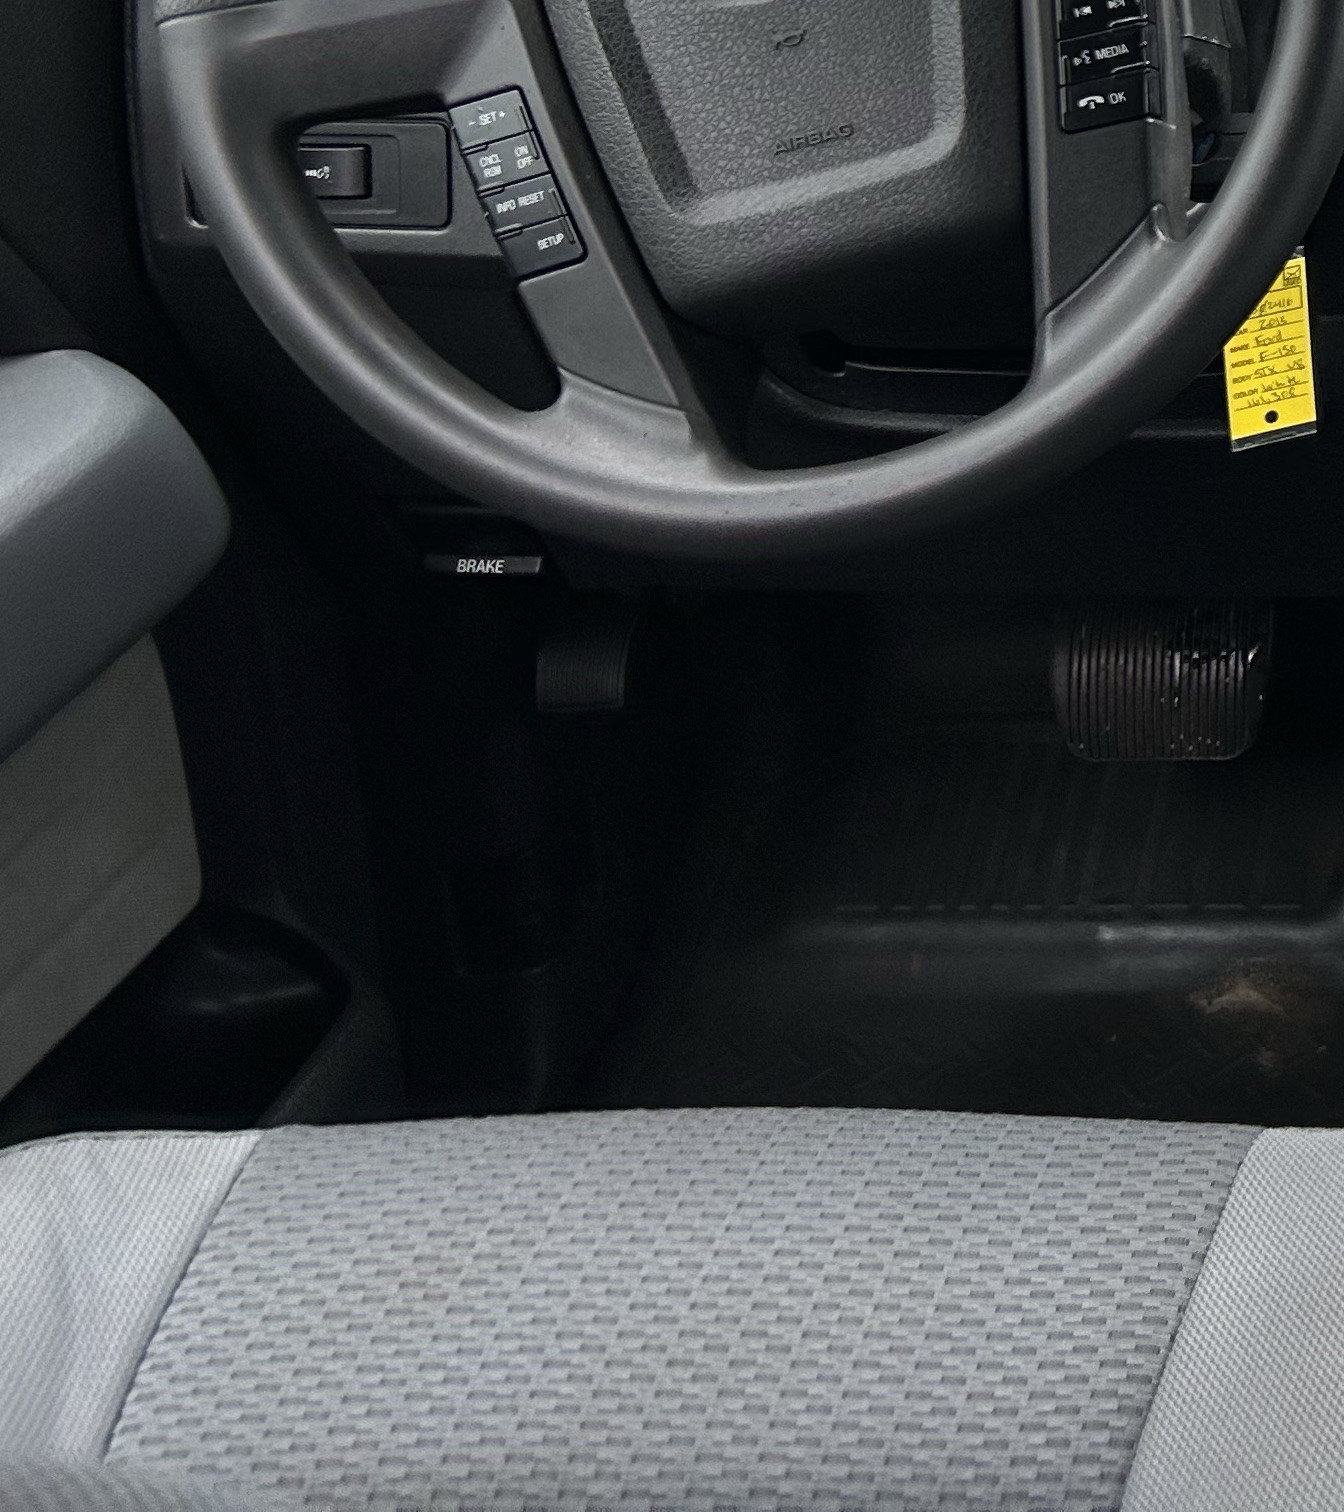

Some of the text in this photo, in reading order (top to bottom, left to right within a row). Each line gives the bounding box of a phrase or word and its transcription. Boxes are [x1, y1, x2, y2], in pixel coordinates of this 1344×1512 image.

[1094, 44, 1130, 61] MEDIA
[1108, 92, 1127, 105] OK
[478, 111, 497, 126] SET
[772, 124, 855, 155] AIRBAG
[514, 145, 529, 157] ON
[517, 157, 534, 169] OFF
[496, 190, 545, 214] INFO RESET
[537, 233, 565, 251] SETUP
[456, 558, 505, 574] BRAKE
